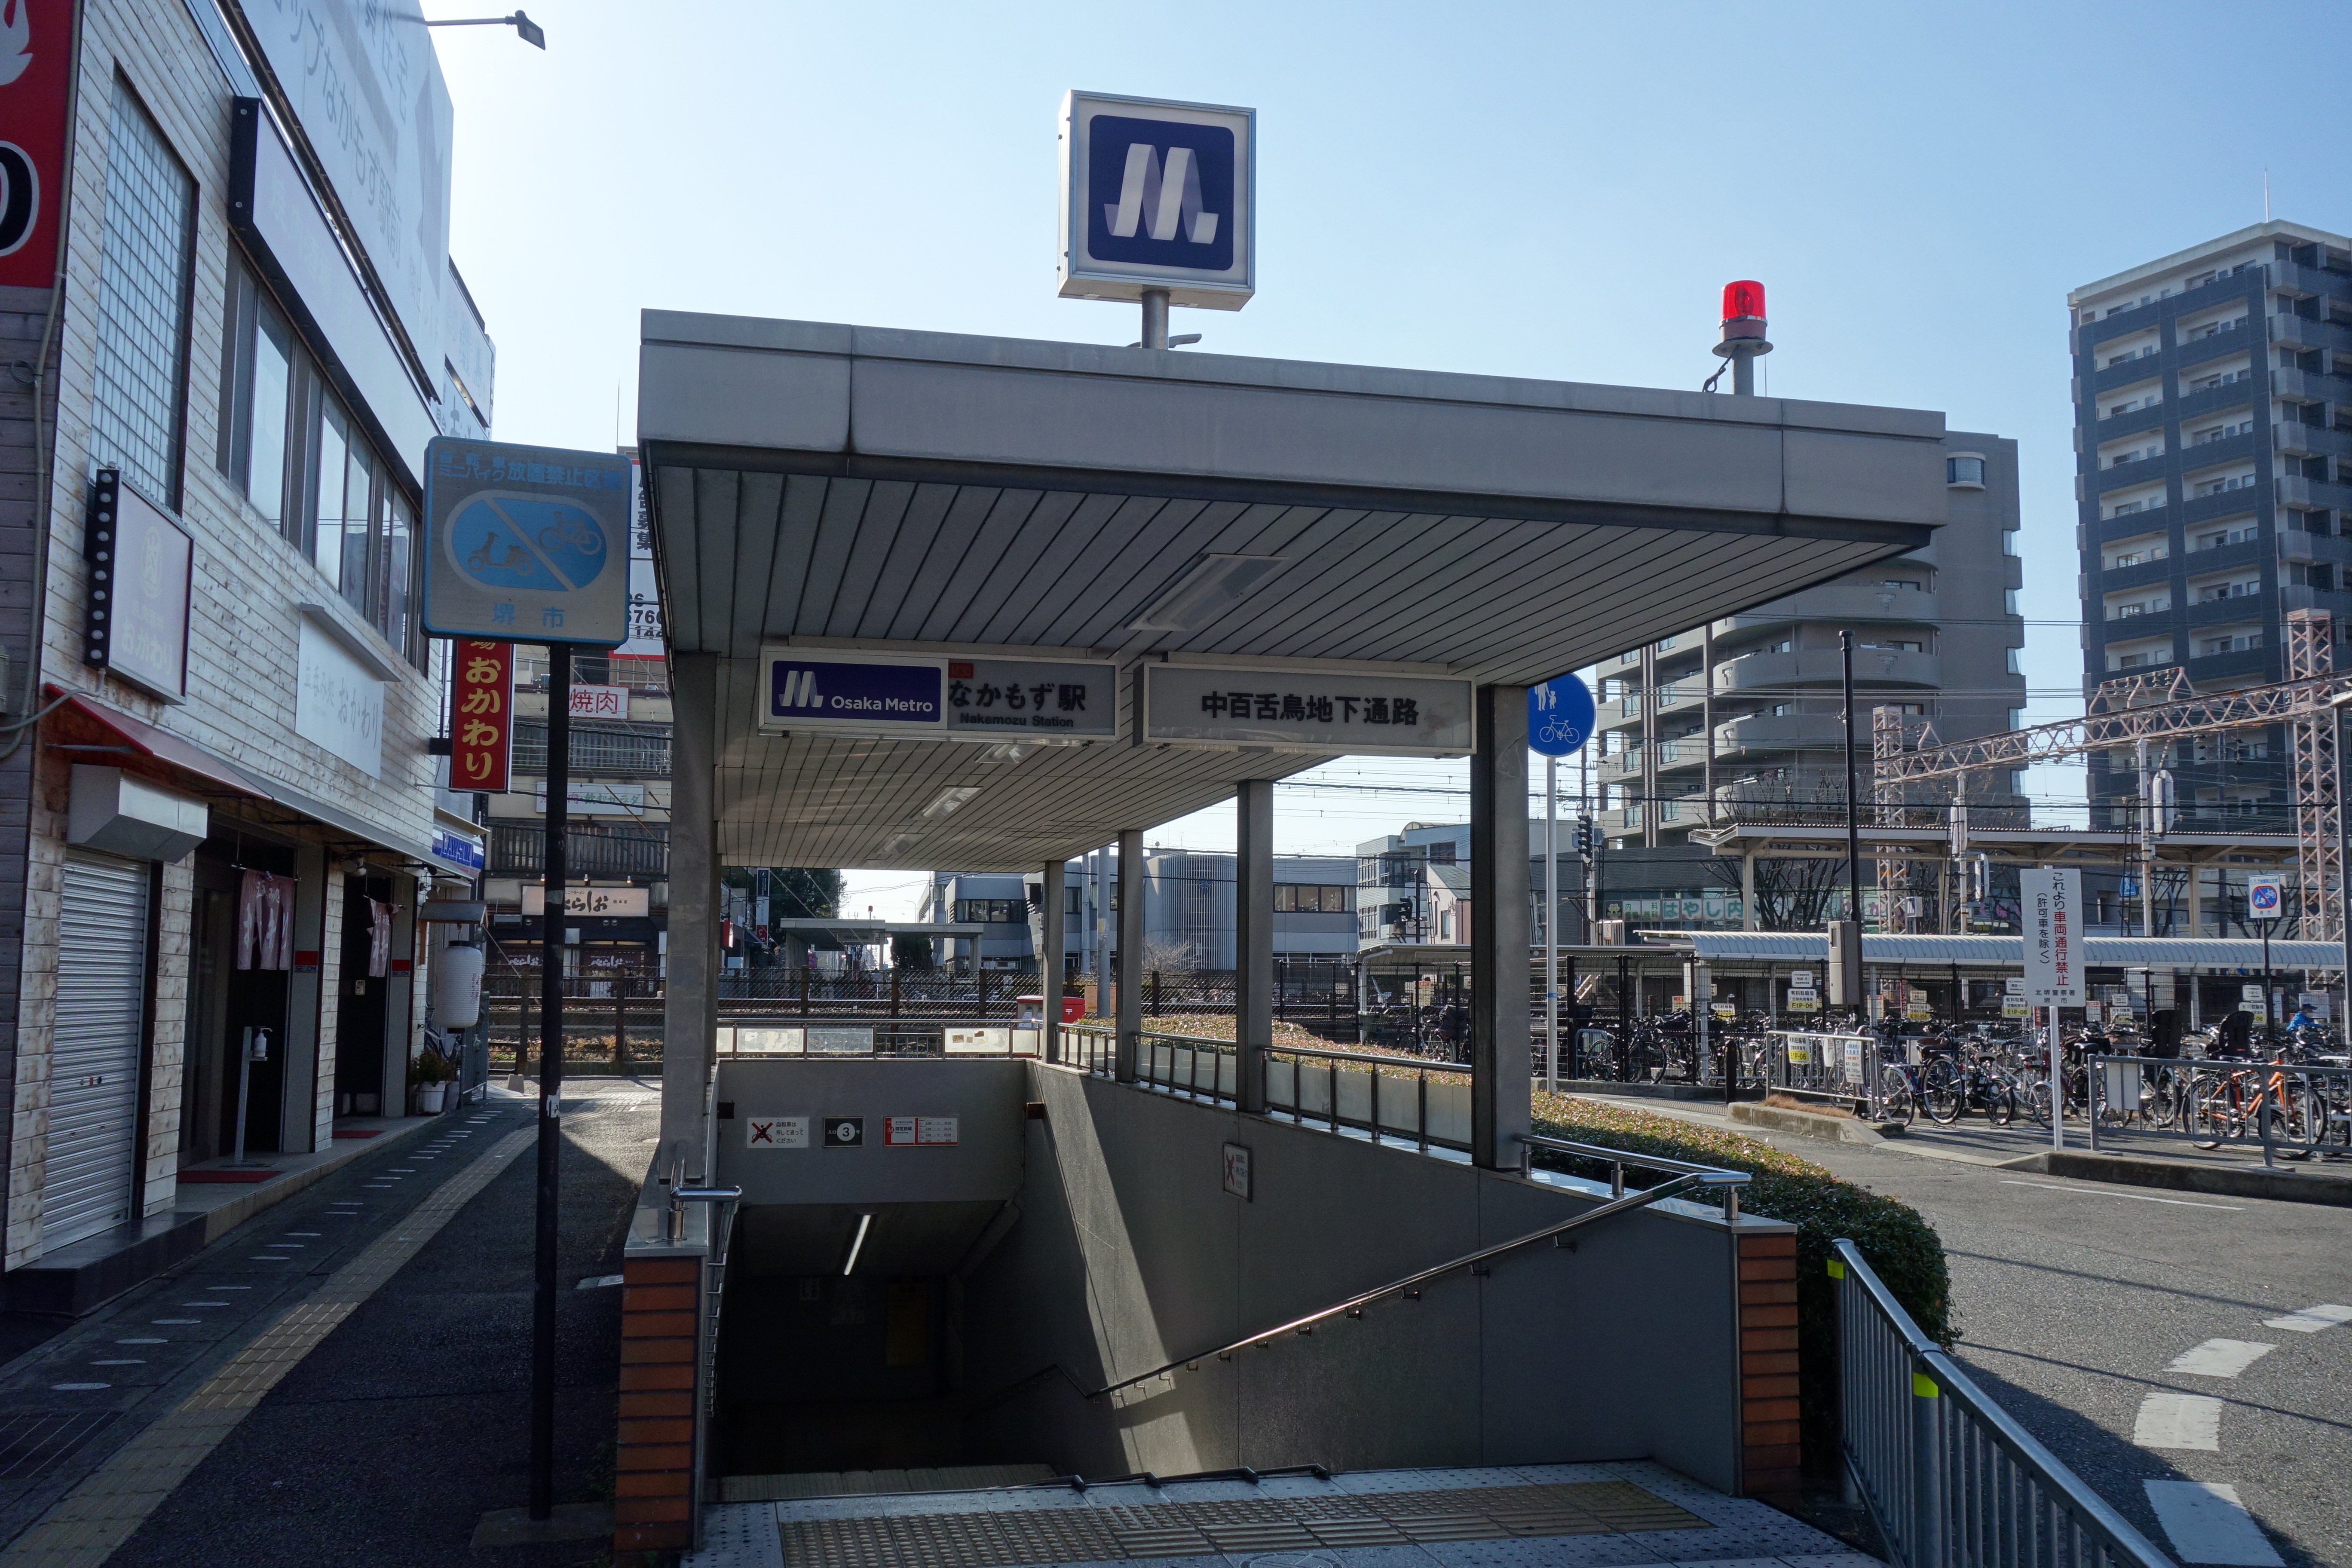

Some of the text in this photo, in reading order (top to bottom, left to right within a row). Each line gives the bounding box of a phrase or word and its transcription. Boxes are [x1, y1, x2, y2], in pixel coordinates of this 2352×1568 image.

[271, 0, 402, 267] ップなかもず駅前
[439, 463, 505, 482] ミニバイク
[629, 593, 645, 607] 6
[570, 688, 619, 714] 焼肉
[831, 695, 882, 710] Osaka
[885, 697, 933, 712] Metro
[948, 680, 1086, 711] なかもず駅
[1201, 690, 1419, 726] 中百舌鳥地下通路
[960, 713, 1074, 727] Nakamozu Station
[441, 831, 474, 867] LAWSON
[1663, 901, 1760, 919] はやし内
[2037, 892, 2050, 965] （許可車を除く）
[2053, 872, 2069, 986] これより車両通行禁止
[842, 1127, 851, 1137] 3
